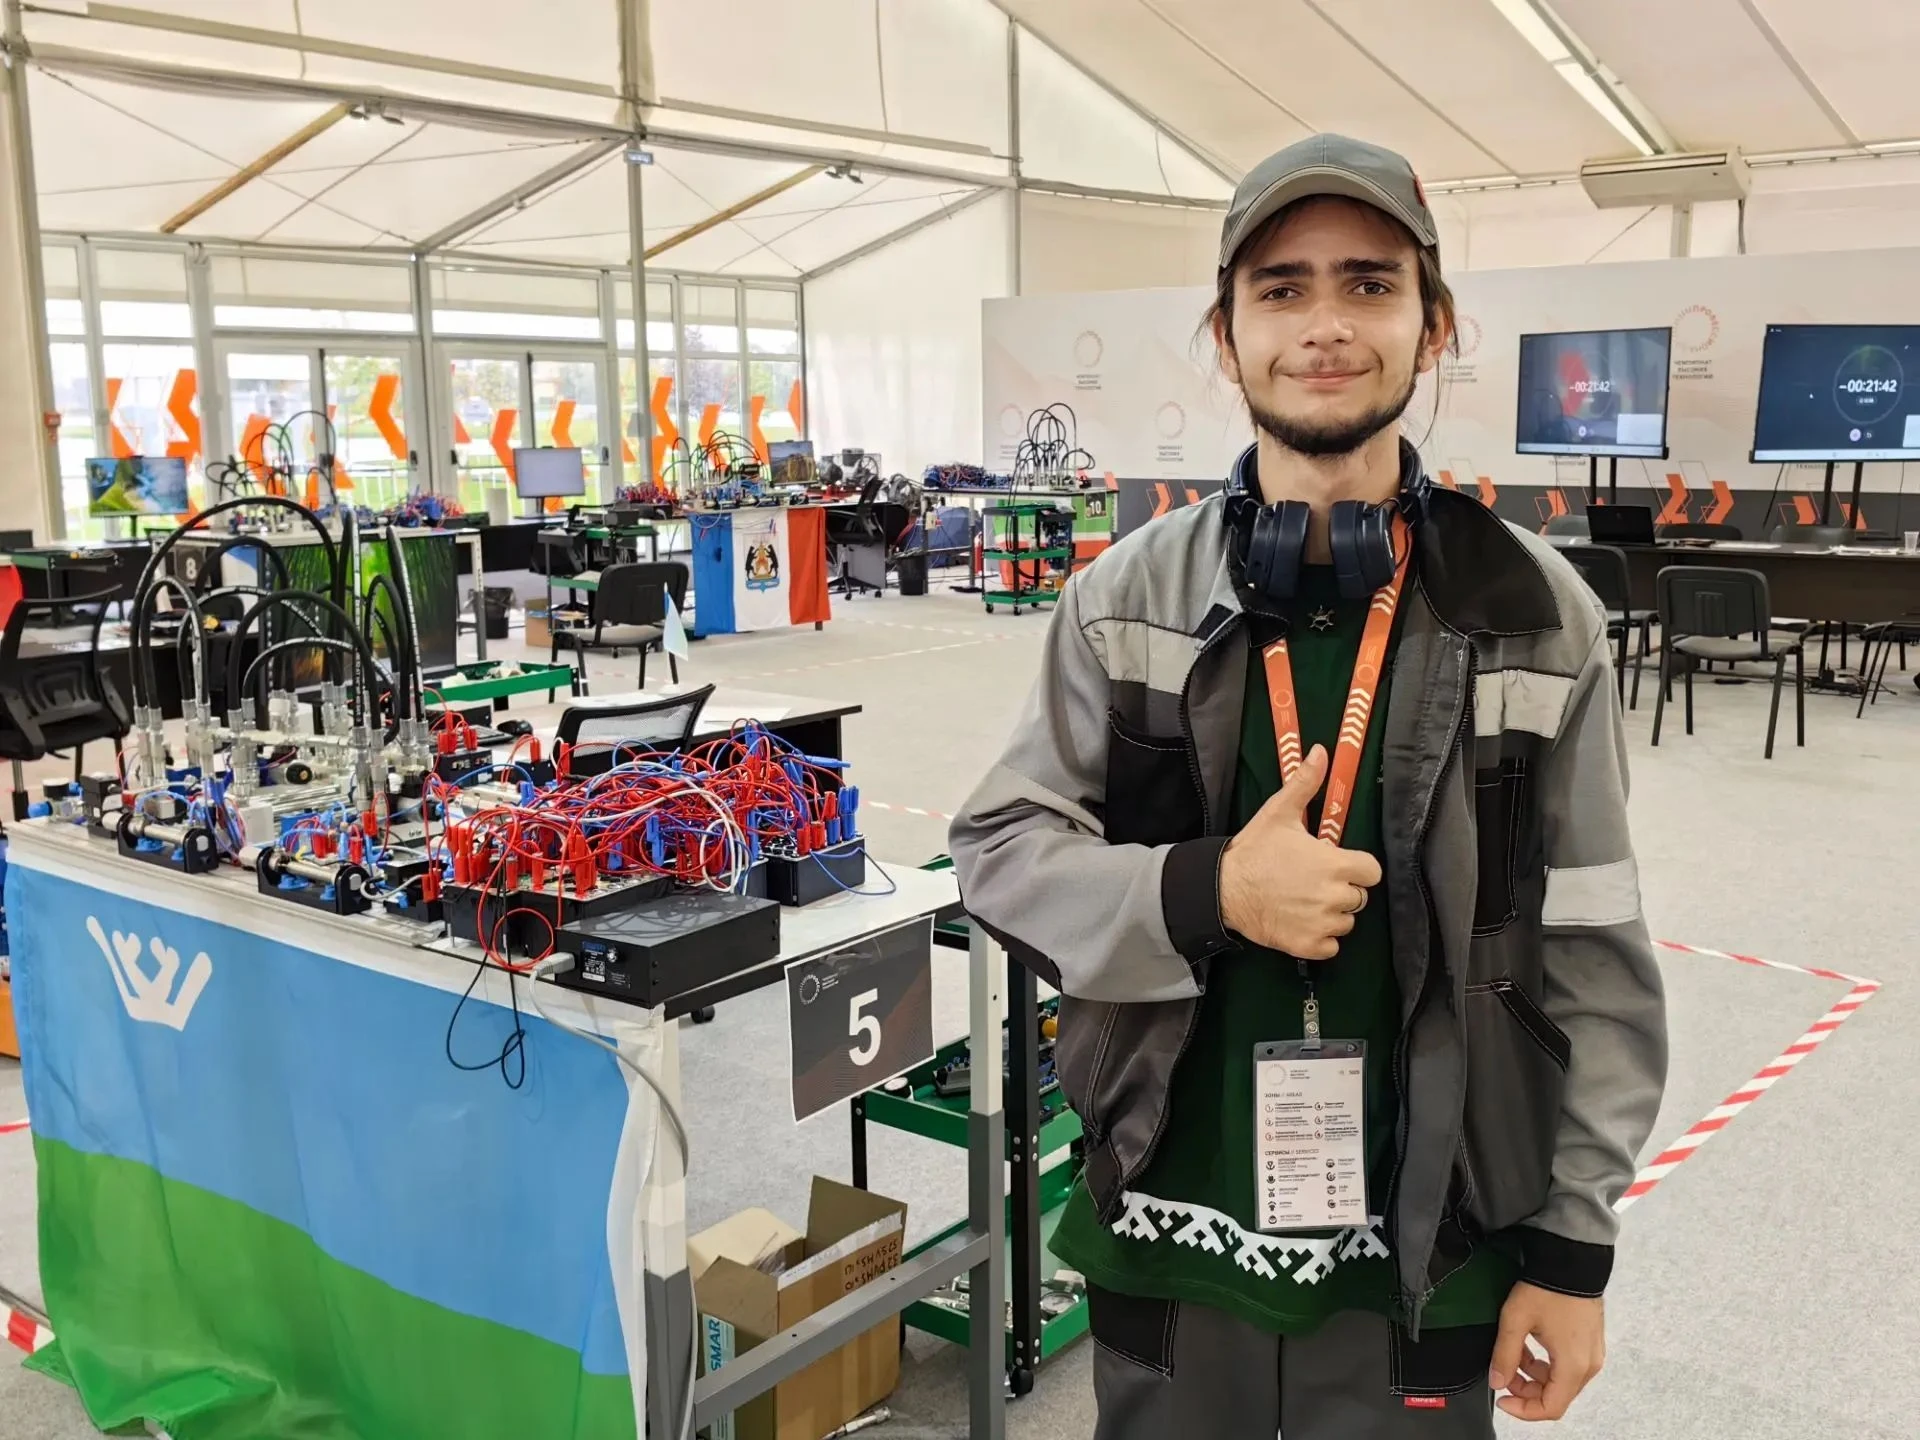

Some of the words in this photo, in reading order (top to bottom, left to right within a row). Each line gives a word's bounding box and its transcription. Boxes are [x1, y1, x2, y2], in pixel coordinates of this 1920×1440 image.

[1089, 500, 1101, 515] 10
[186, 557, 197, 580] 8
[849, 987, 882, 1066] 5
